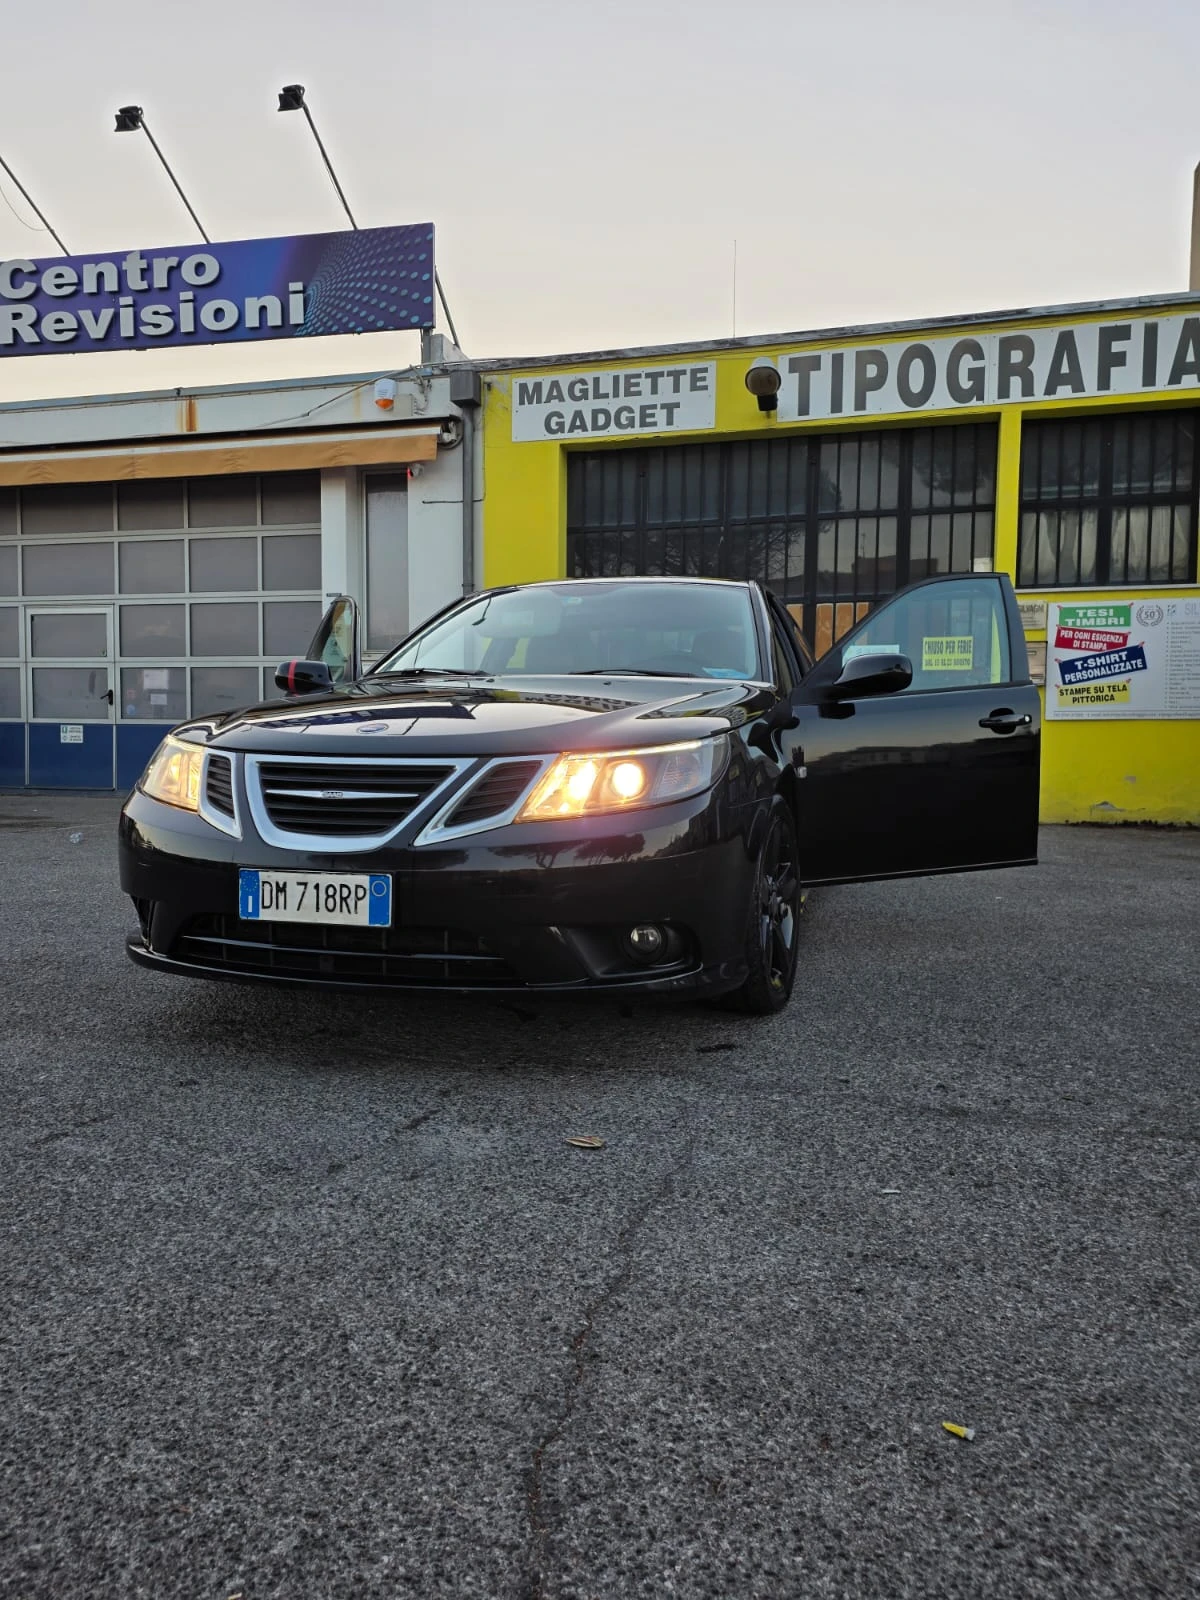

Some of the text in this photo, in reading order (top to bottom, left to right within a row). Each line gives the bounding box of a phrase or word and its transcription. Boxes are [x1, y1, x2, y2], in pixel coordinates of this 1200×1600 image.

[0, 251, 220, 299] Centro
[0, 282, 305, 345] Revisioni
[788, 317, 1200, 416] TIPOGRAFIA
[518, 367, 709, 406] MAGLIETTE
[544, 402, 680, 435] GADGET
[1065, 617, 1125, 627] TIMBRI
[1075, 608, 1114, 617] TESI
[1060, 630, 1123, 643] PER OGNI ESIGENZA
[1073, 639, 1107, 650] DI STAMPA
[925, 640, 944, 654] CHIUSO
[1074, 651, 1128, 670] T-SHIRT
[1064, 658, 1143, 684] PERSONALIZZATE
[1060, 684, 1128, 697] STAMPE SU TELA
[1072, 694, 1115, 704] PITTORICA
[261, 880, 367, 914] DM 718RP
